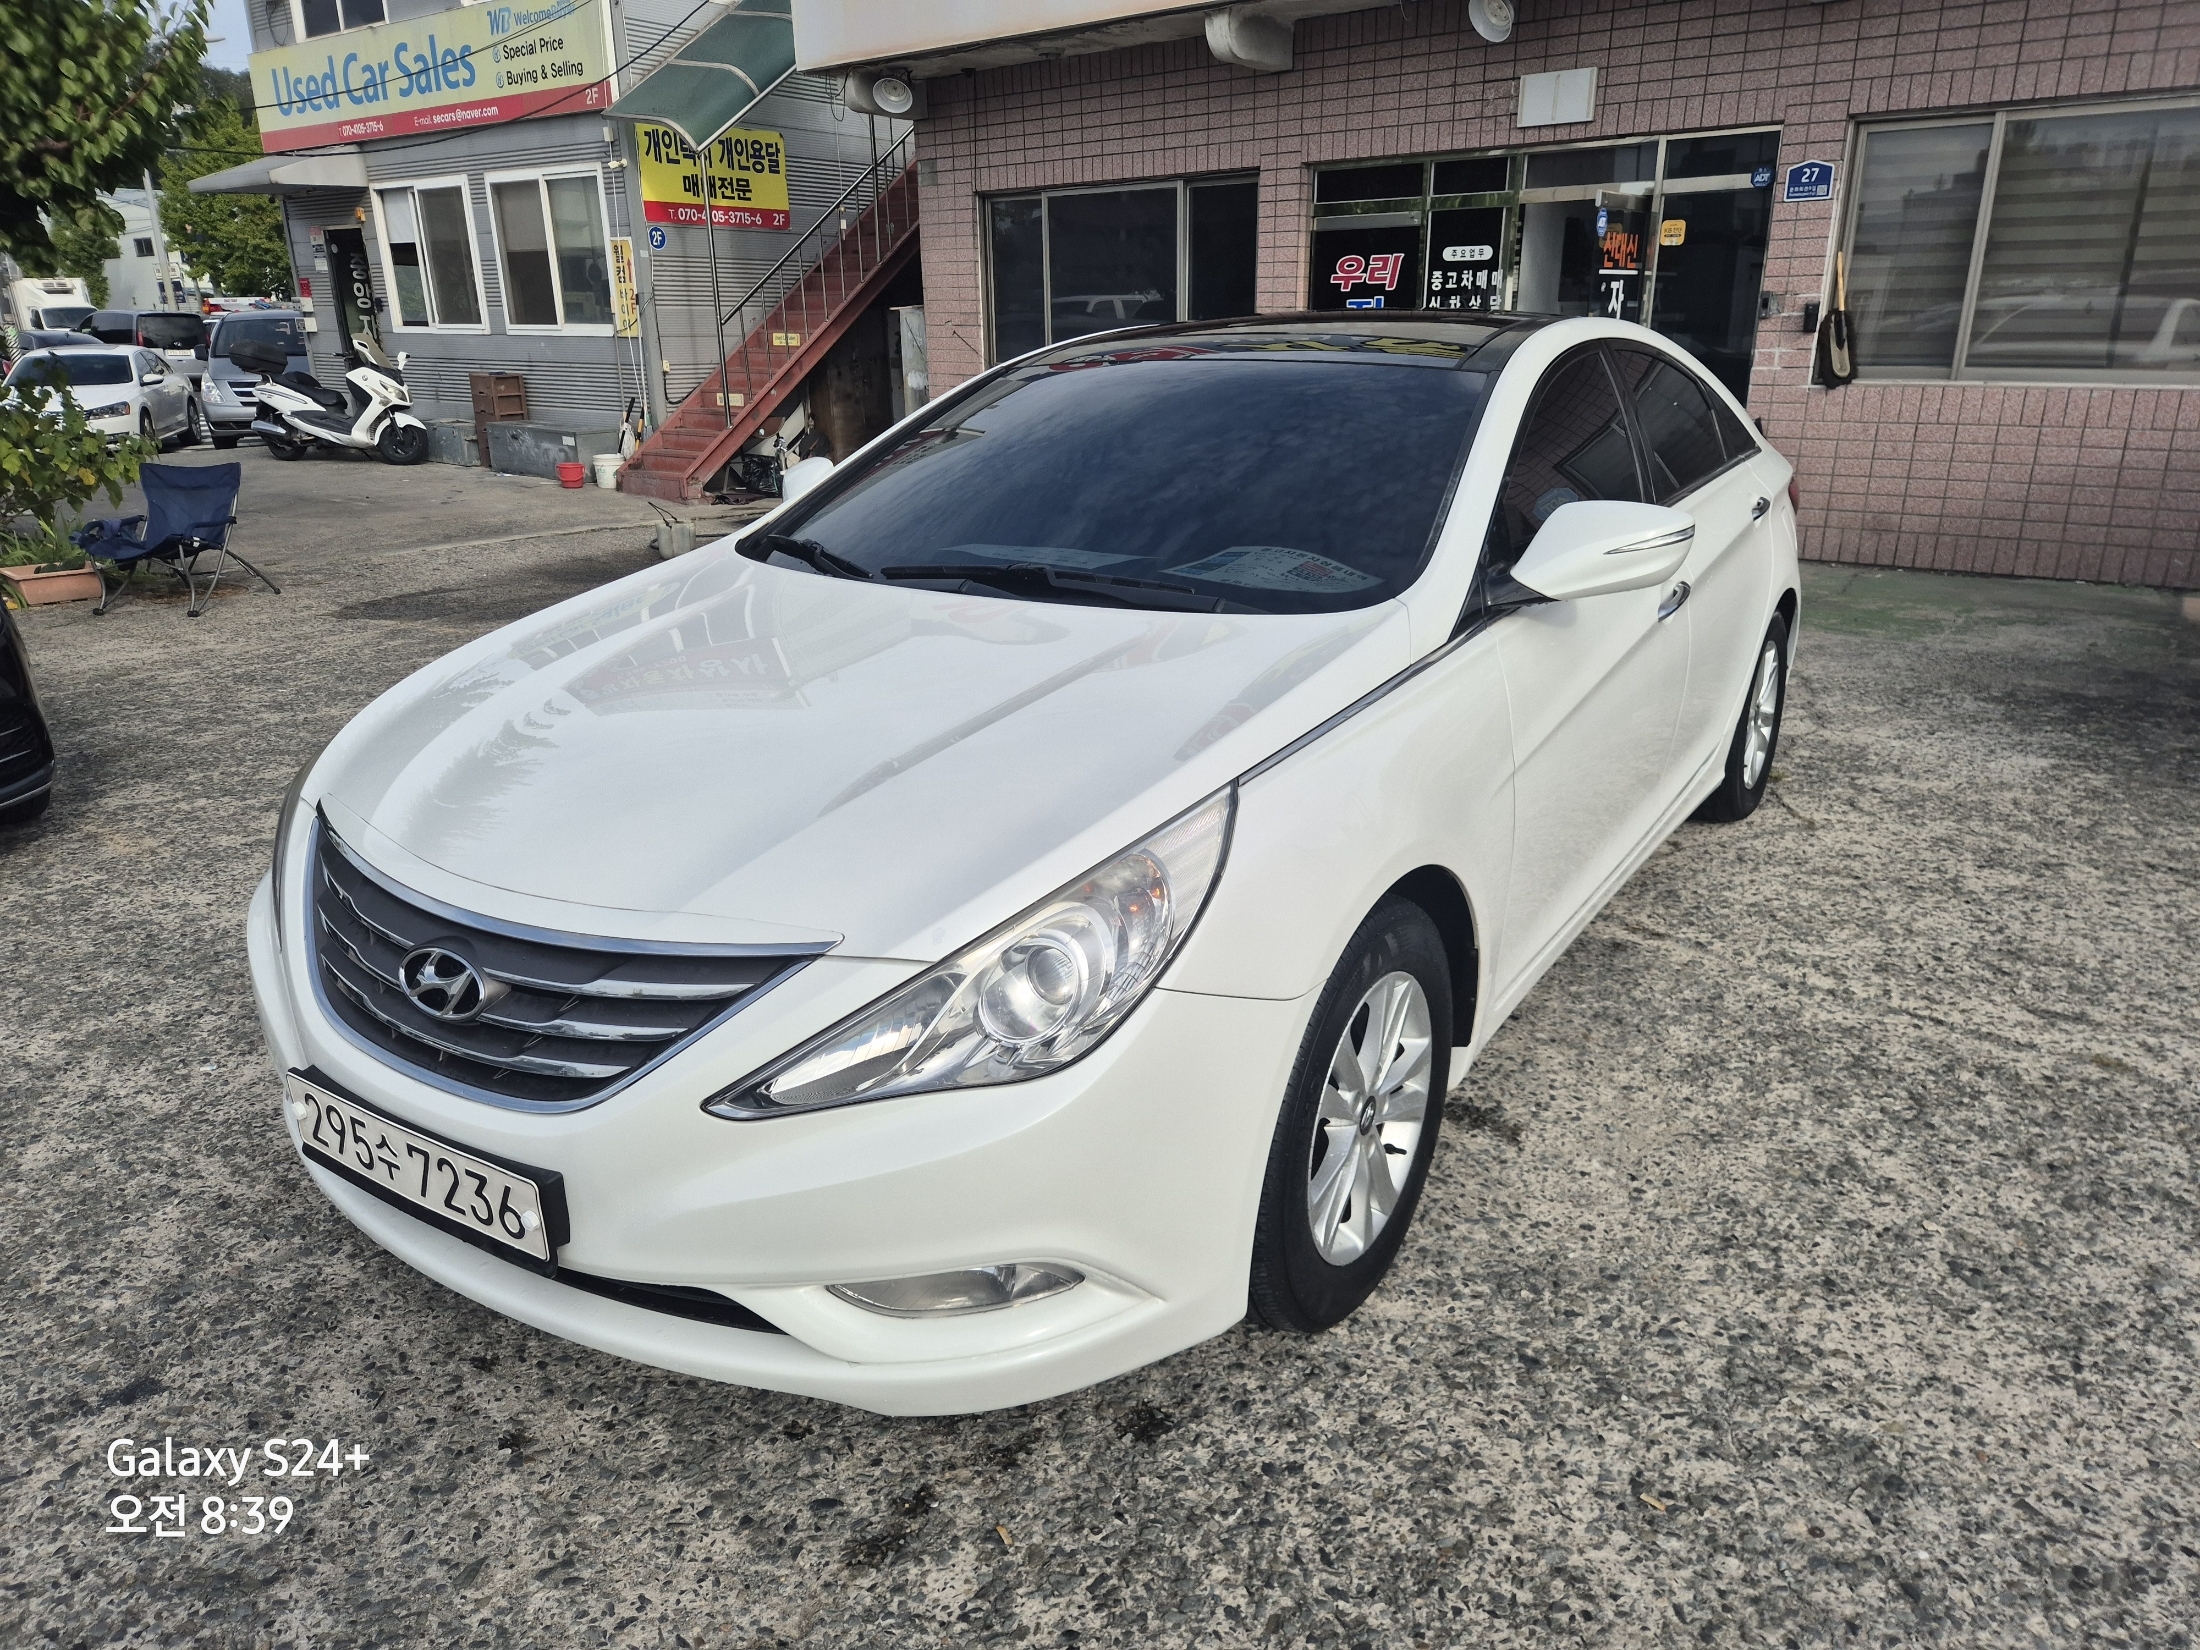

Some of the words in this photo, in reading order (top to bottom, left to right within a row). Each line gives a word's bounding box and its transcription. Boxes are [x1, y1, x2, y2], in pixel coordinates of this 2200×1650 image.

[503, 40, 537, 61] Special
[539, 36, 564, 53] Price
[271, 54, 339, 117] Used
[343, 52, 389, 103] Car
[394, 34, 476, 98] Sales
[506, 68, 538, 86] Buying
[541, 64, 548, 80] &
[550, 61, 584, 79] Selling
[585, 87, 599, 105] 2F
[432, 106, 499, 125] secars@naver.com
[718, 137, 781, 175] 개인용달
[1753, 172, 1771, 182] ADT
[1801, 167, 1820, 183] 27
[678, 208, 762, 225] 070-405-3715~6
[772, 213, 785, 226] 2F
[651, 230, 663, 246] 2F
[1330, 253, 1405, 292] 우리
[1431, 269, 1503, 291] 중고차매매
